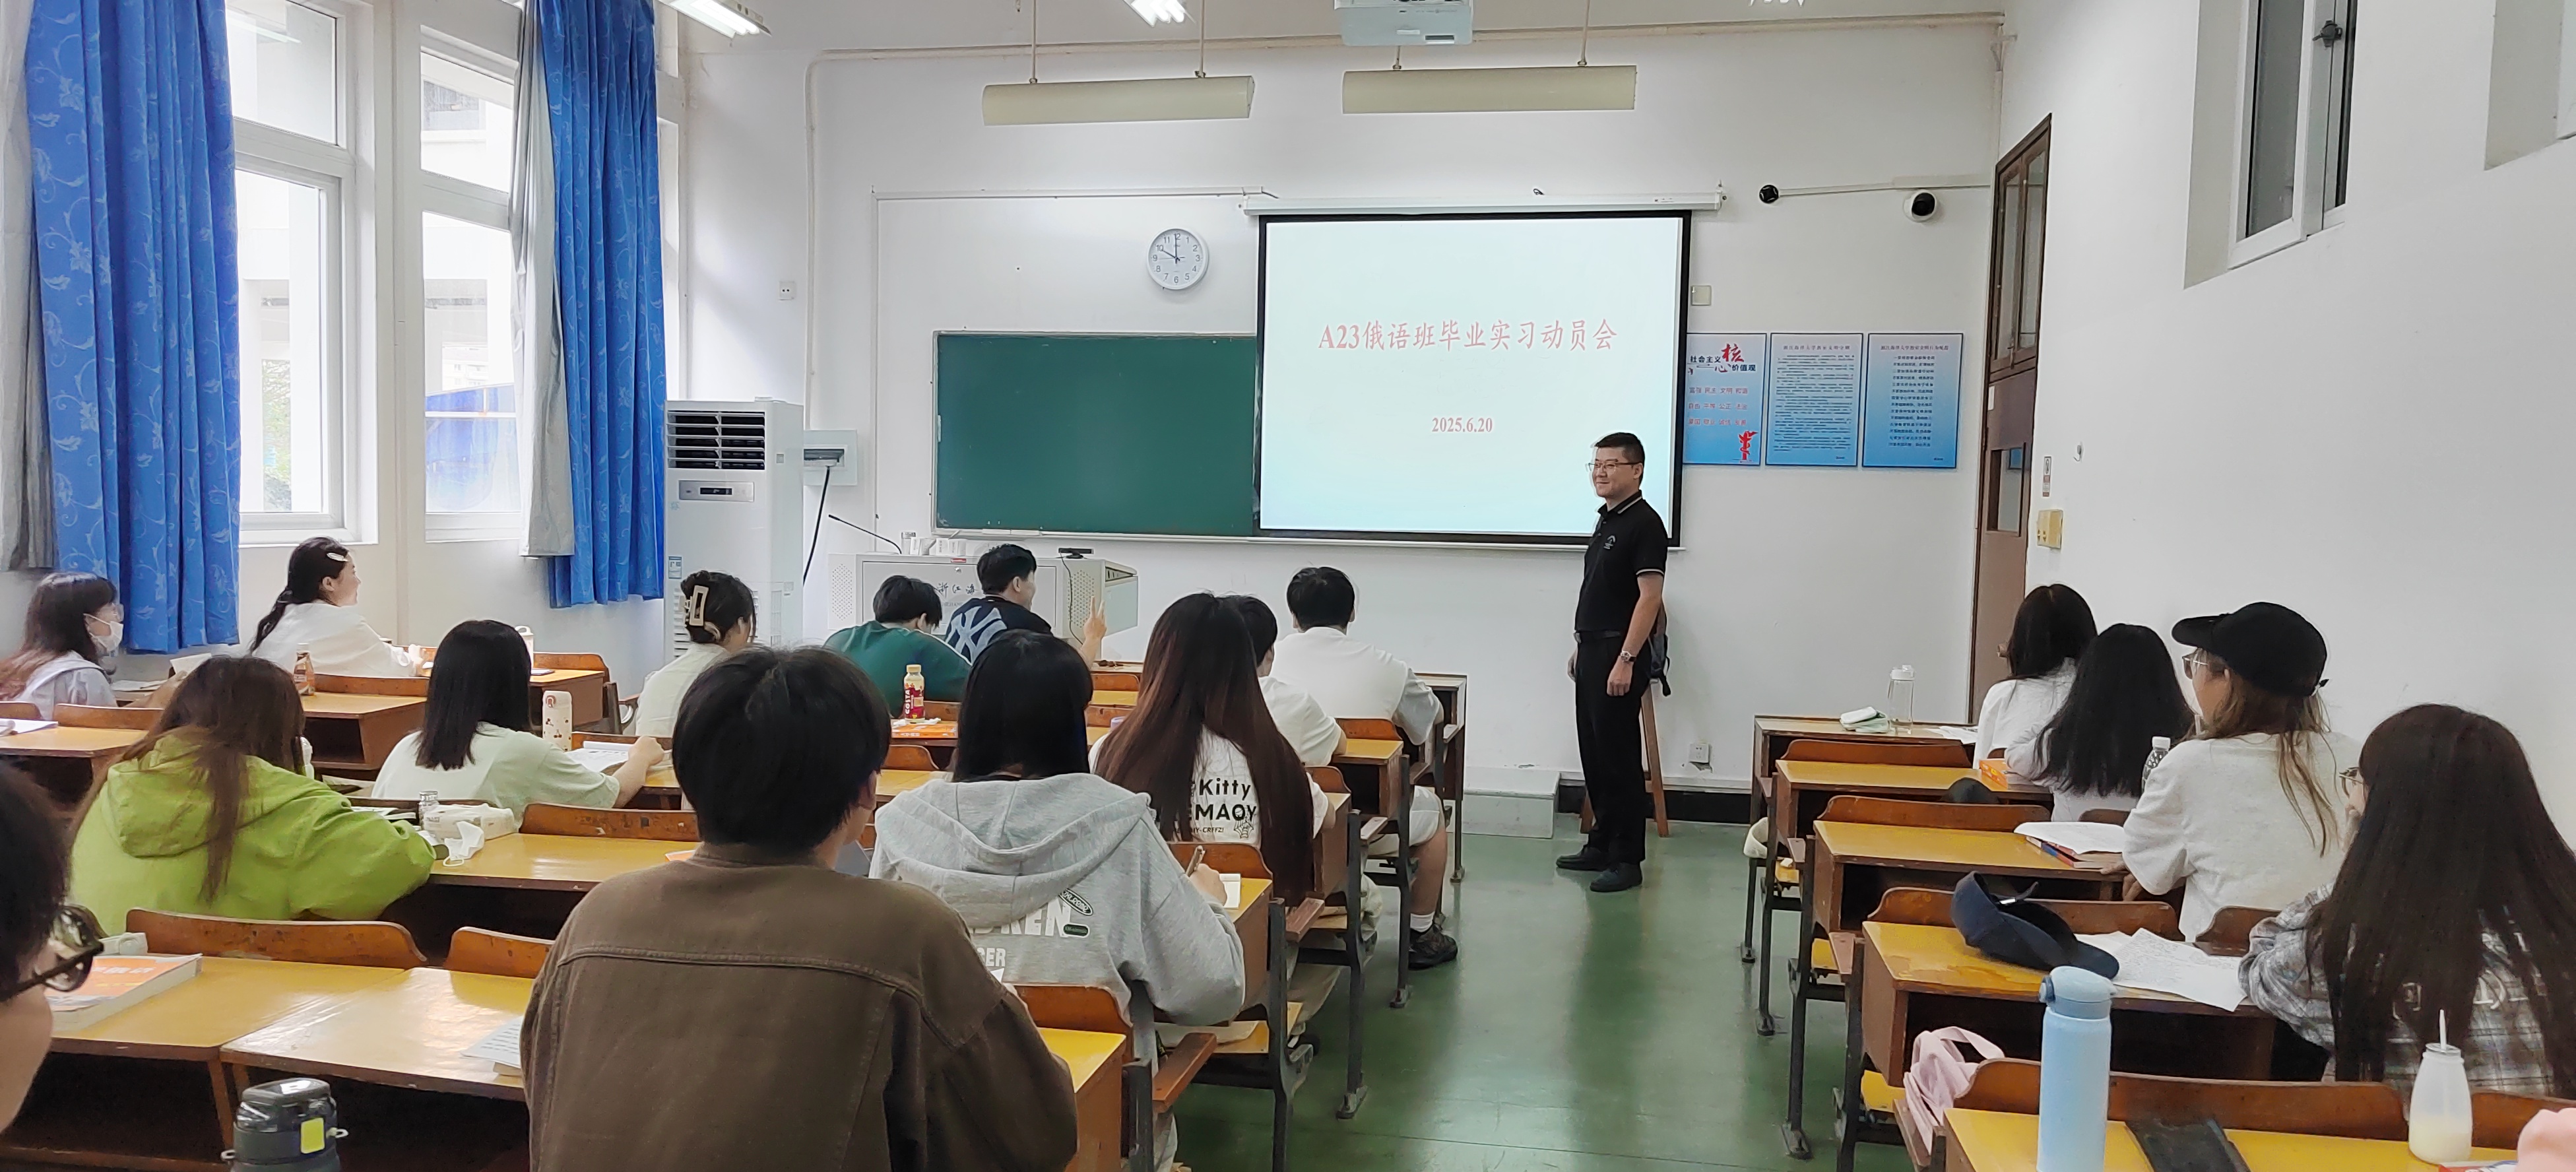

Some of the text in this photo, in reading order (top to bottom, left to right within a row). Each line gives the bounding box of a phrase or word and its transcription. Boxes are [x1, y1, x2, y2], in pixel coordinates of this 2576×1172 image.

[1317, 318, 1617, 352] A23俄语班毕业实习动员会
[1432, 417, 1493, 434] 2025.6.20
[1199, 777, 1251, 801] Kitty
